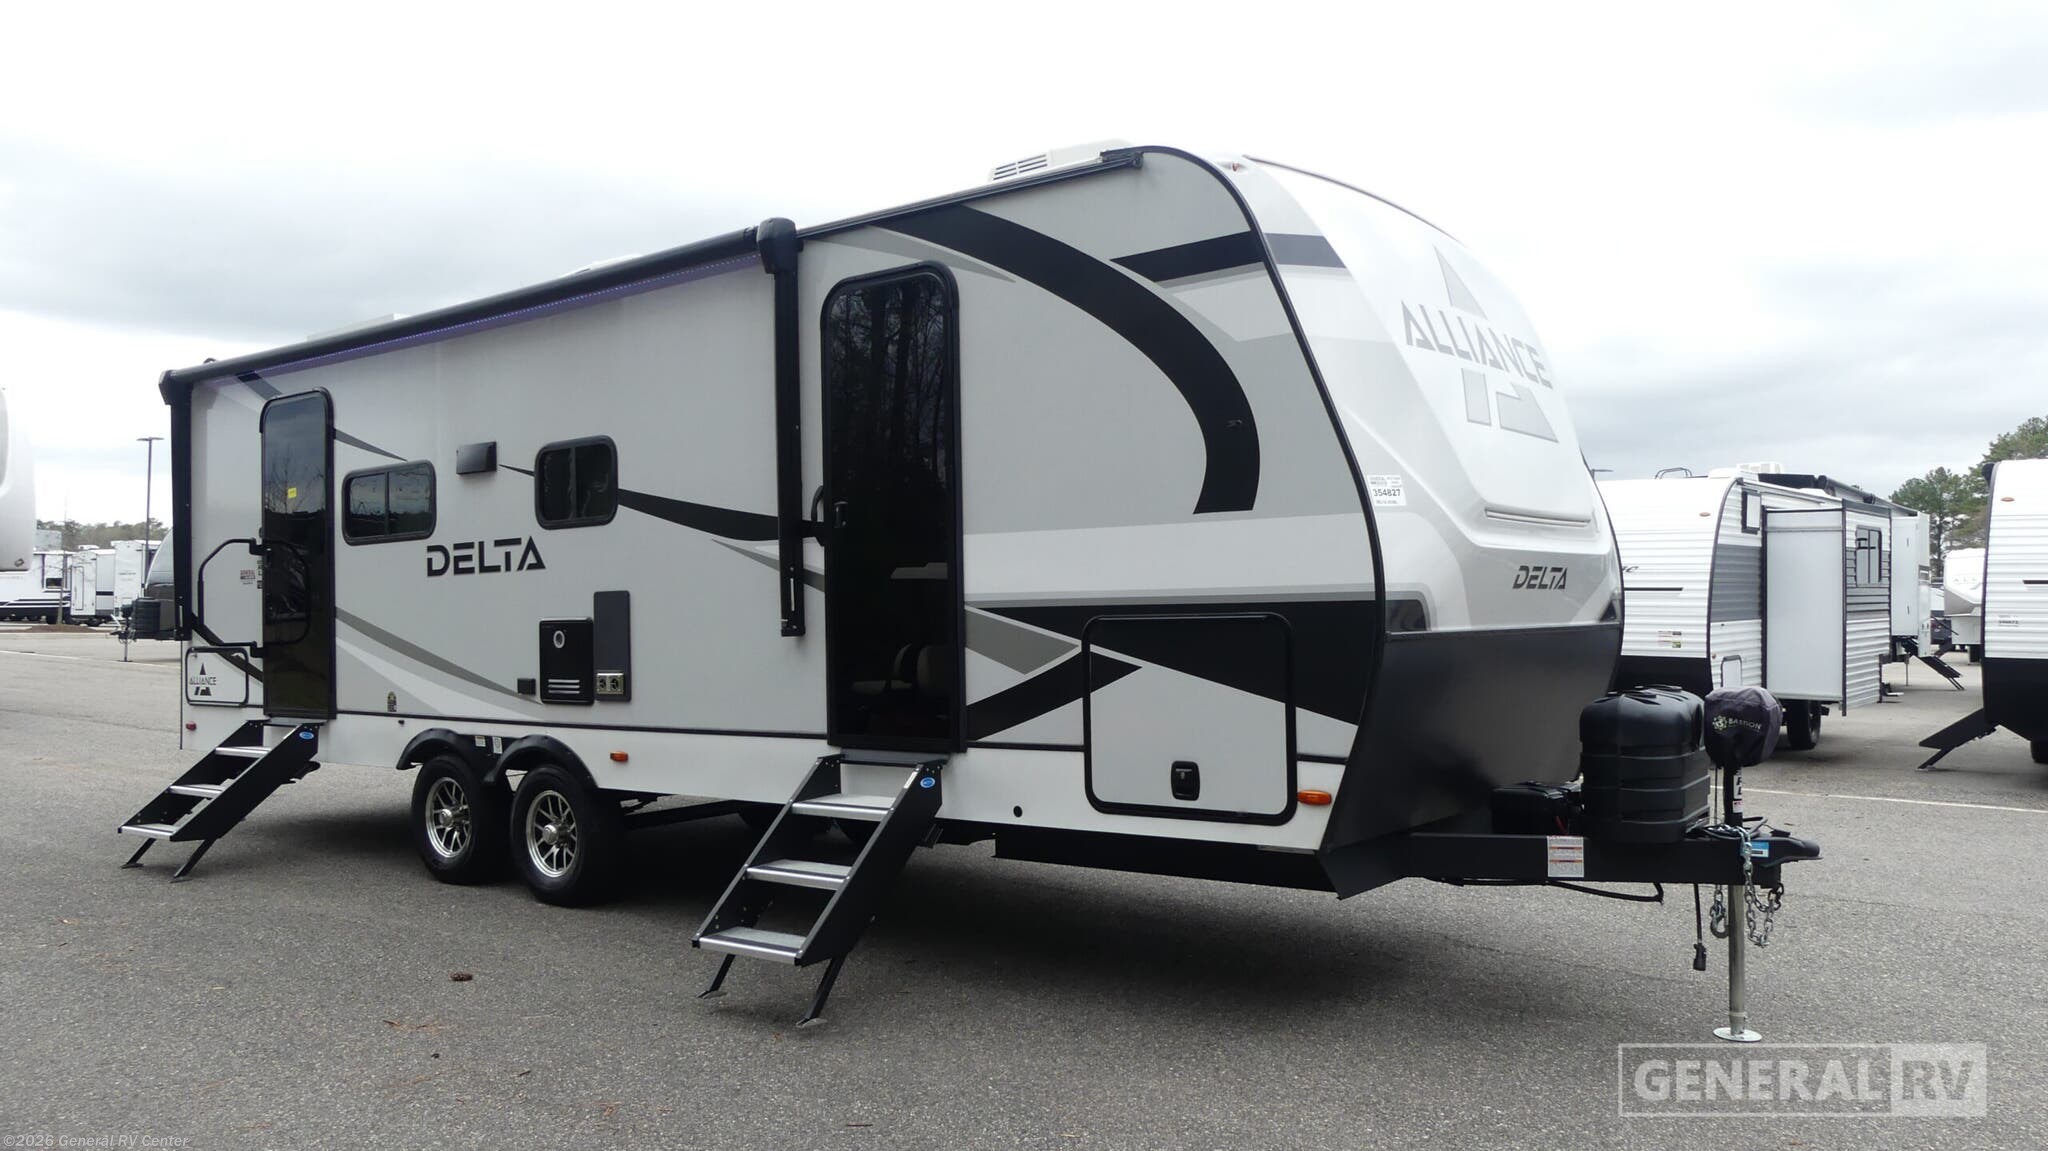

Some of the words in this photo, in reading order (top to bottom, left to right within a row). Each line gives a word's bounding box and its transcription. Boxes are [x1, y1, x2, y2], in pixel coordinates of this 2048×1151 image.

[1401, 300, 1553, 389] ALLIANCE
[1372, 488, 1401, 497] 354827
[426, 535, 546, 577] DELTA
[1512, 565, 1568, 590] DELTA
[189, 676, 216, 686] ALLIANCE
